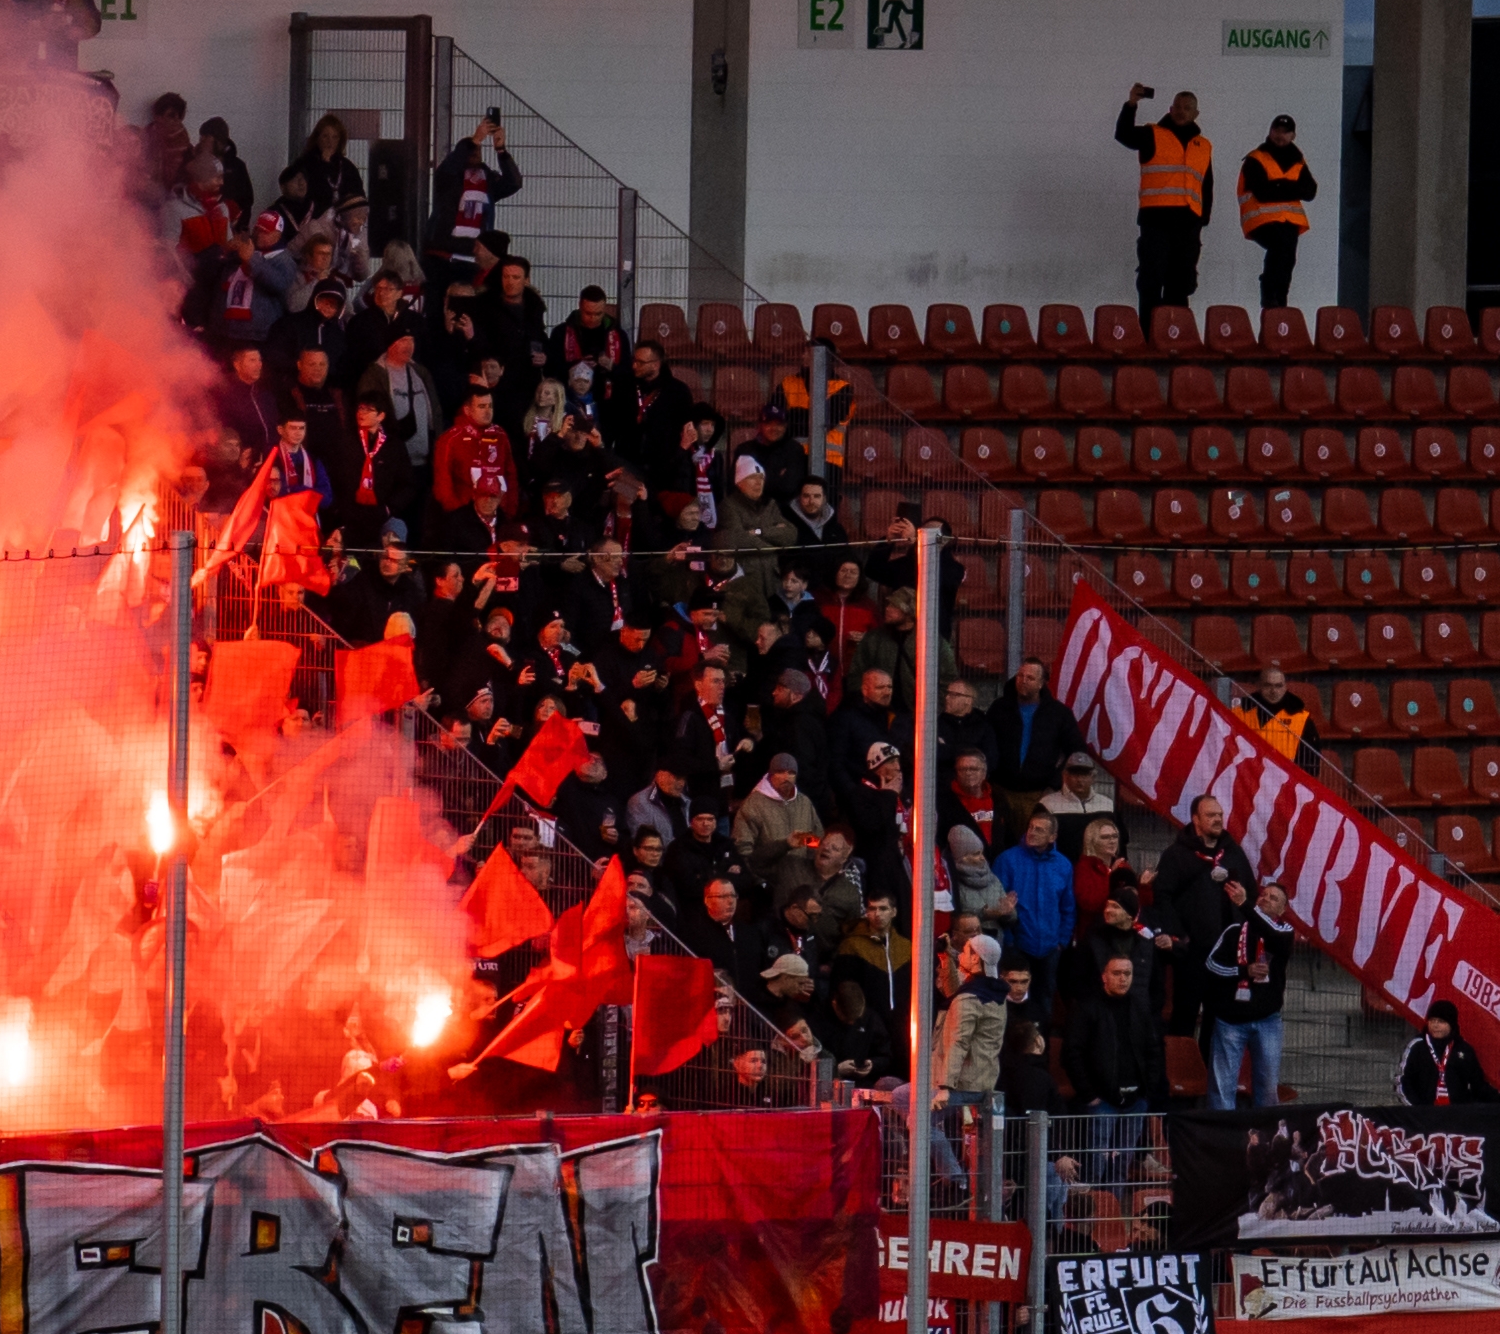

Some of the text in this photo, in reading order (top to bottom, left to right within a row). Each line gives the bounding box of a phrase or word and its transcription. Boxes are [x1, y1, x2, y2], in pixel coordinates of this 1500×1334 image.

[1227, 27, 1312, 51] AUSGANG
[1057, 606, 1465, 1019] OSTKURVE
[1057, 1254, 1200, 1293] ERFURT
[1261, 1247, 1489, 1292] Erfurt Auf Achse
[1084, 1293, 1111, 1315] FC
[1282, 1287, 1459, 1311] Die Fussballpsychopathen
[1079, 1308, 1125, 1334] RWE
